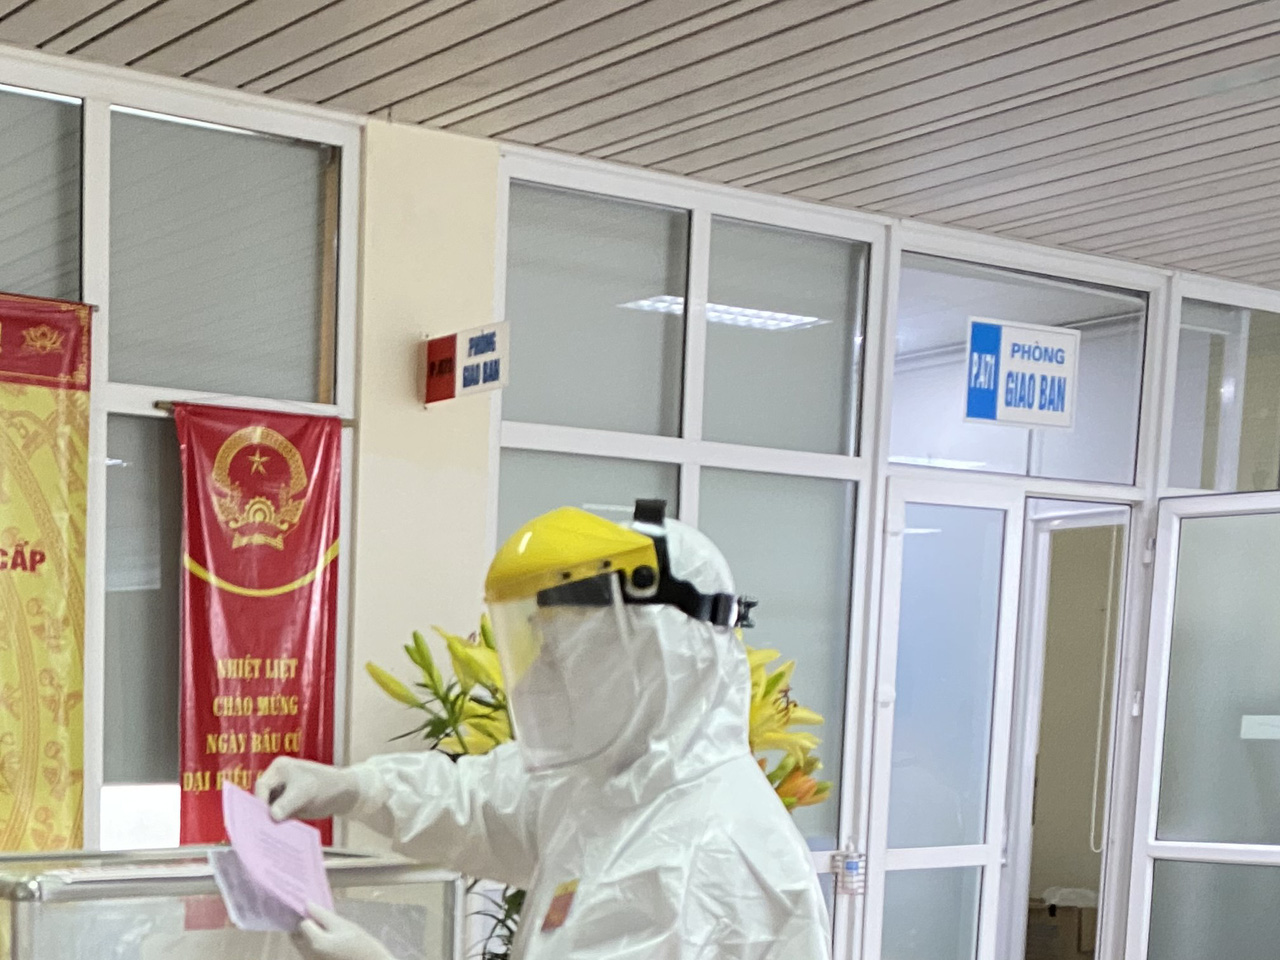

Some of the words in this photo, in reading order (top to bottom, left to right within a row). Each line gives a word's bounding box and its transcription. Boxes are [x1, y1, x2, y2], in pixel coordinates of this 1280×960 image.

[1010, 341, 1066, 365] PHÒNG
[1004, 371, 1036, 409] GIAO
[1038, 374, 1067, 412] BAN
[216, 653, 262, 683] NHIỆT
[265, 653, 299, 683] LIỆT
[206, 728, 247, 755] NGÀY
